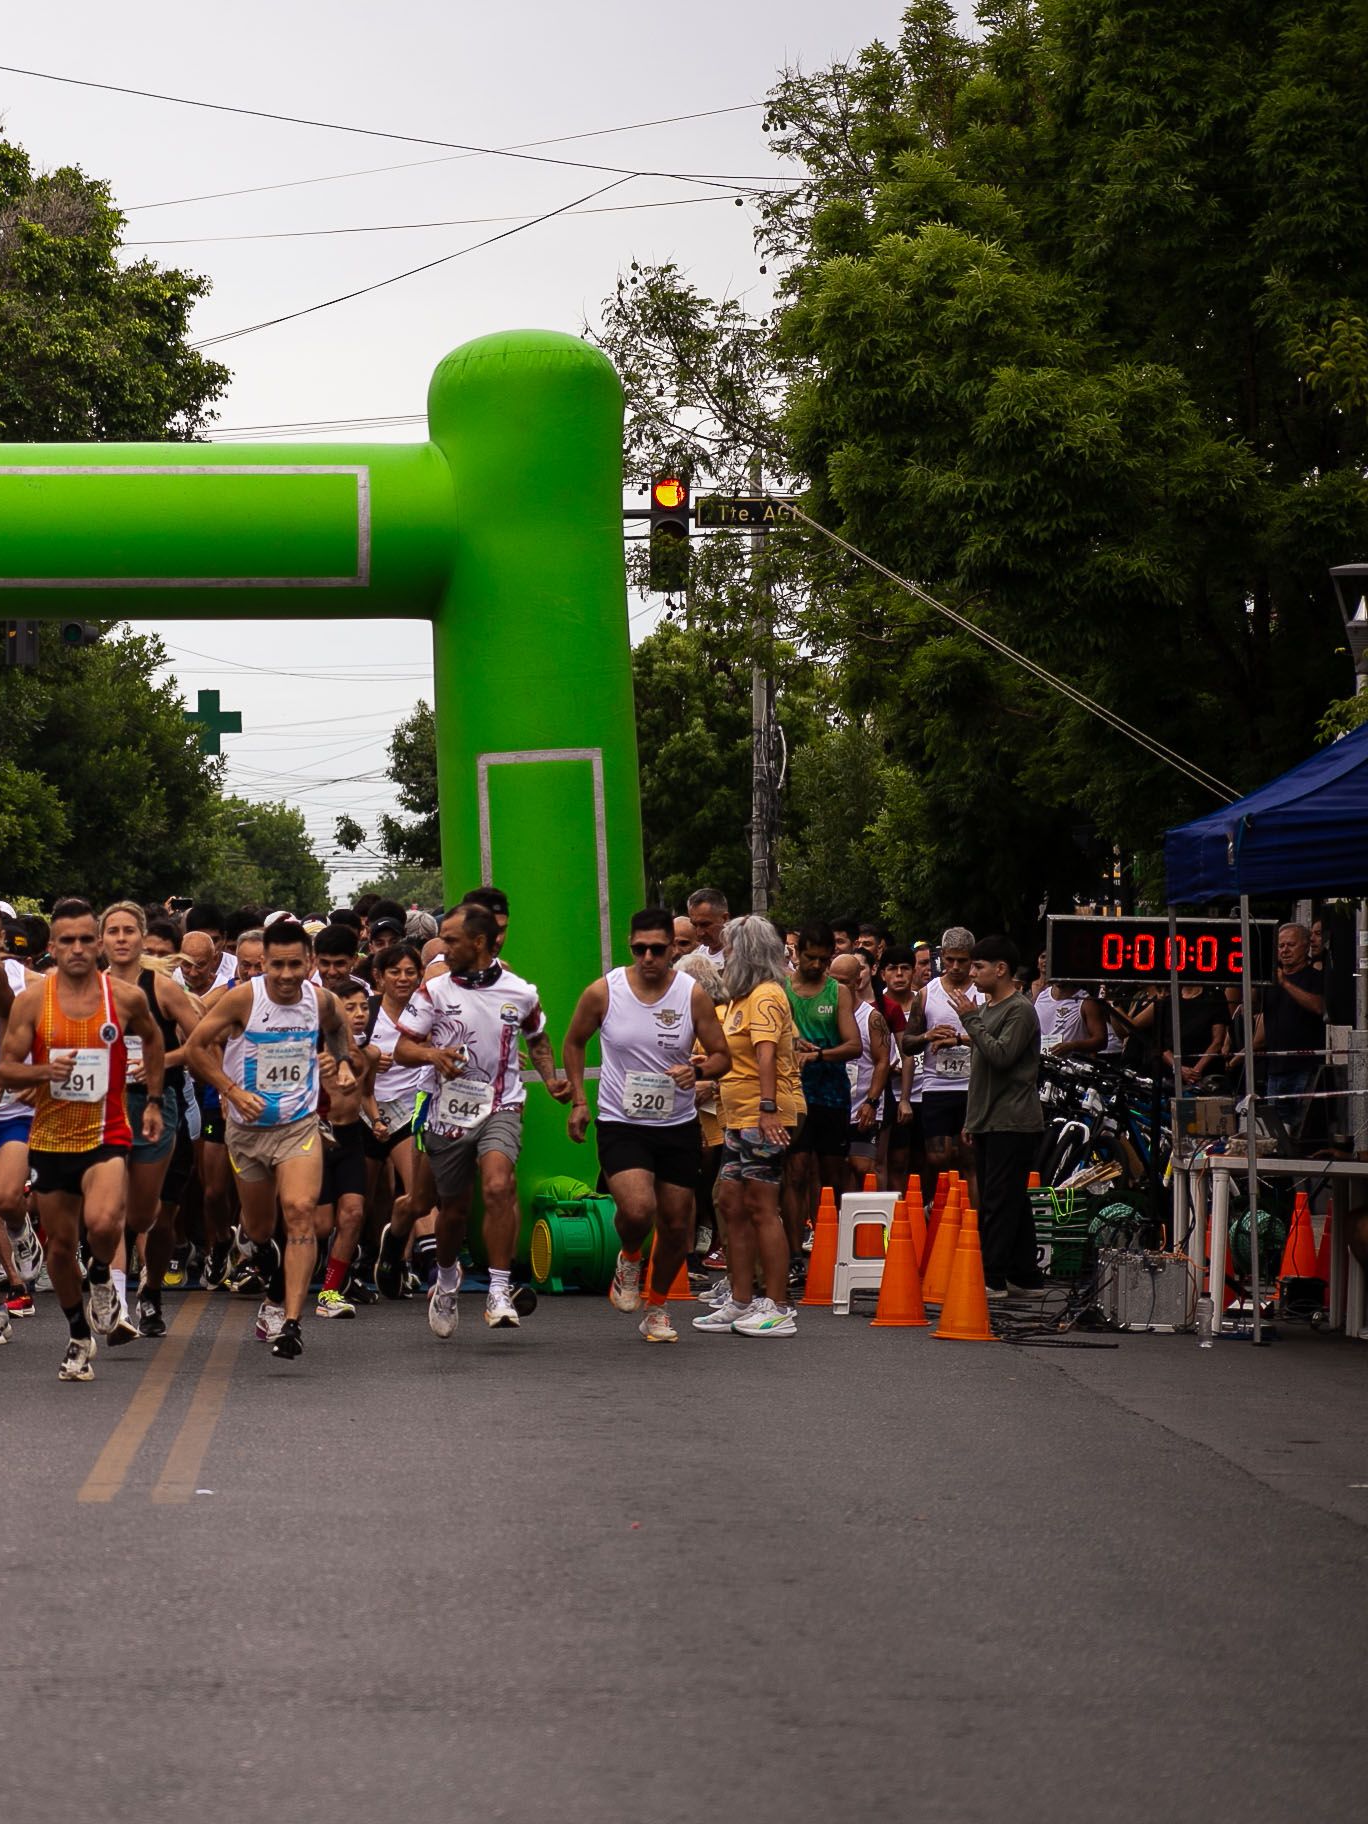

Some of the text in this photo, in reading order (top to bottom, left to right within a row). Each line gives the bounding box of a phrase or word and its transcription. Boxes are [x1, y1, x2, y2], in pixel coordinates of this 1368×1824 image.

[817, 1005, 833, 1014] CM
[265, 1025, 310, 1033] ARGENTINA
[266, 1065, 301, 1082] 416
[943, 1060, 965, 1072] 147
[60, 1073, 95, 1092] 291
[448, 1098, 480, 1118] 644
[632, 1092, 665, 1110] 320
